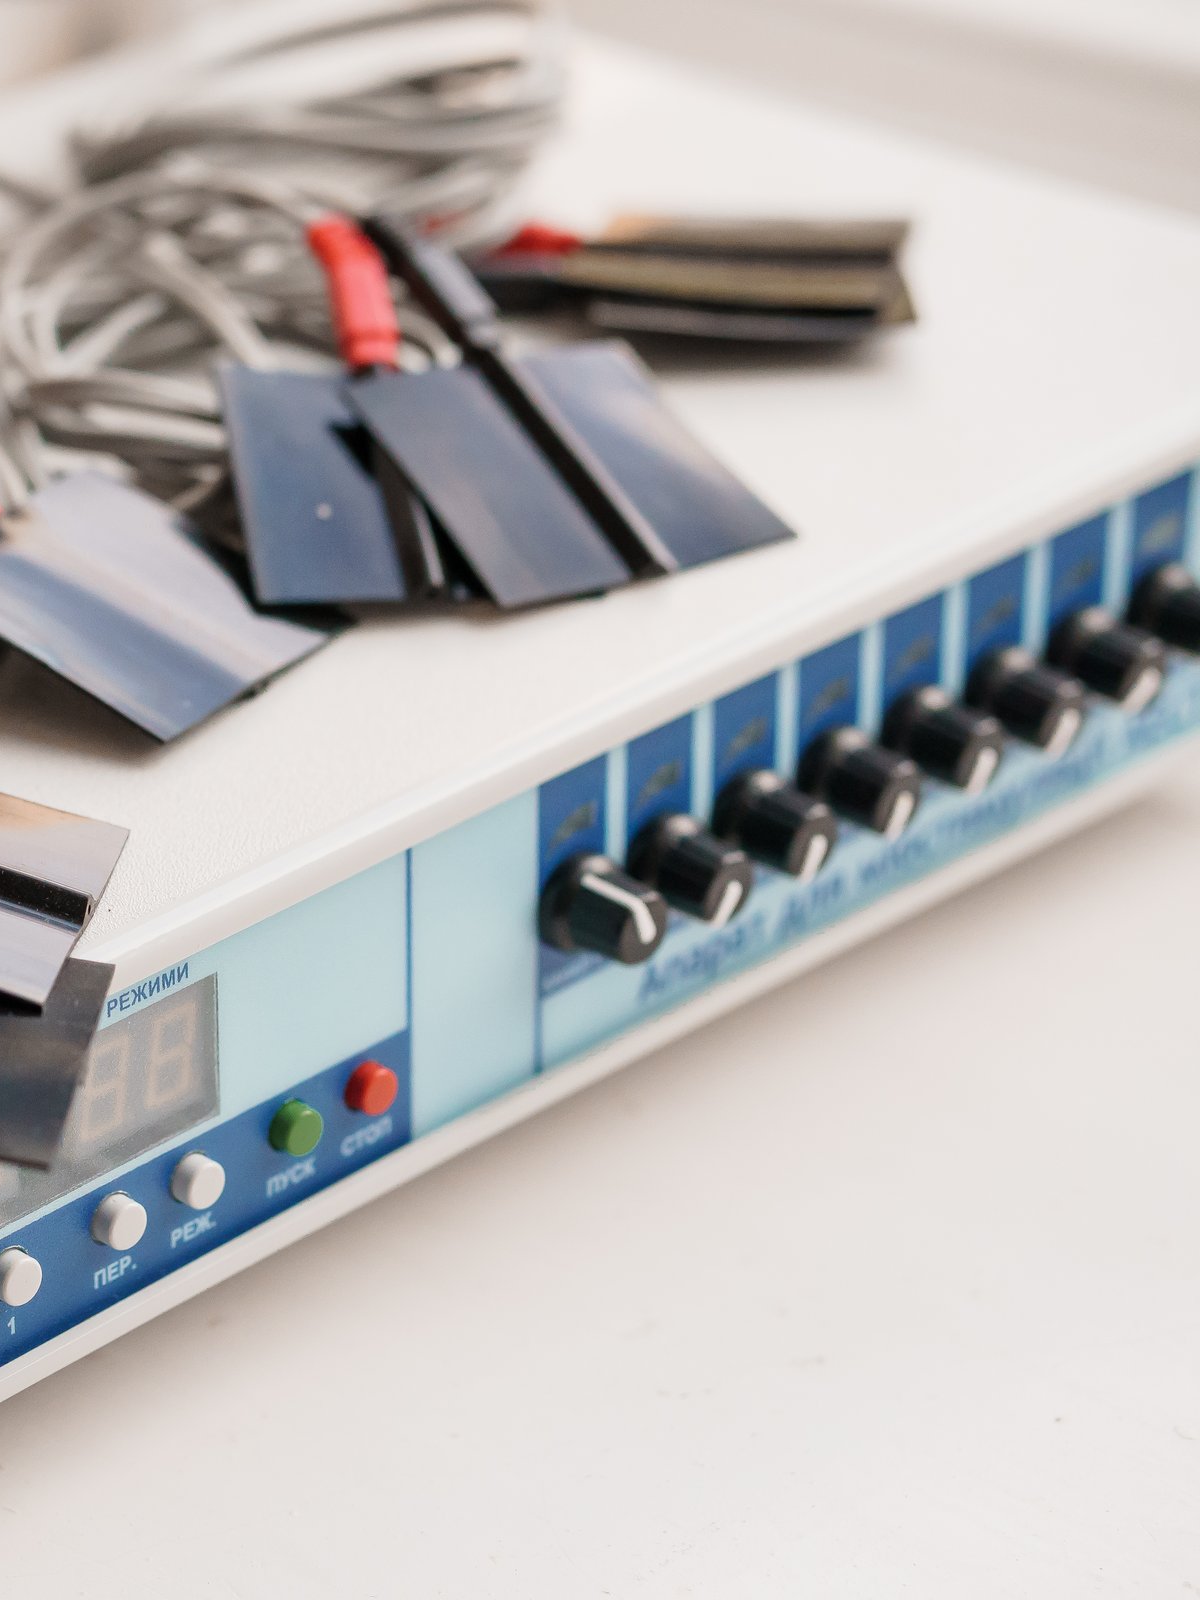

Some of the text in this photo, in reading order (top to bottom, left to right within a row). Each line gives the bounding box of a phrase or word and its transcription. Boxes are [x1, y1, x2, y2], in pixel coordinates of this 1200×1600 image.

[106, 962, 189, 1018] РЕЖИМИ
[340, 1115, 393, 1157] СТОП
[170, 1212, 216, 1248] РЕЖ.
[93, 1255, 137, 1290] ПЕР.
[6, 1316, 17, 1335] 1
